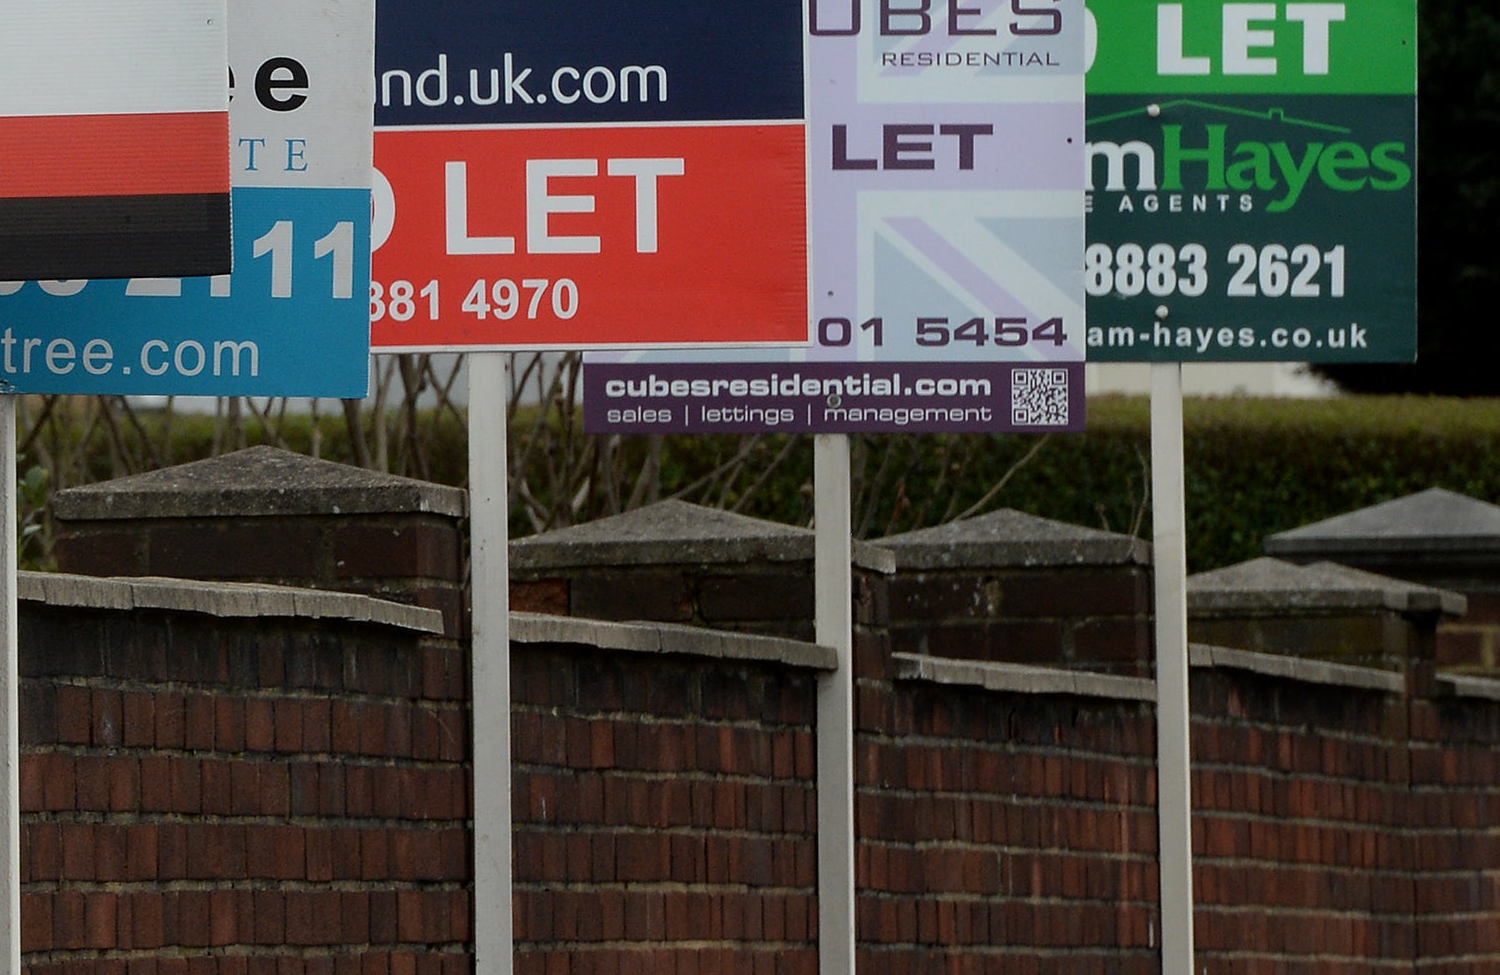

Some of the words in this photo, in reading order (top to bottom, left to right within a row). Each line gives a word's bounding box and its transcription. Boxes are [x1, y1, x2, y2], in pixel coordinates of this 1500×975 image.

[1156, 2, 1346, 76] LET
[881, 52, 1060, 67] RESIDENTIAL
[373, 52, 669, 107] nd.uk.com
[831, 123, 994, 171] LET
[444, 157, 686, 256] LET
[1118, 194, 1253, 213] AGENTS
[1085, 242, 1209, 298] 8883
[1226, 243, 1346, 298] 2621
[460, 277, 580, 321] 4970
[816, 316, 884, 348] 01
[915, 316, 1069, 348] 5454
[1086, 321, 1369, 354] am-hayes.co.uk
[605, 373, 993, 398] cubesresidential.com
[606, 405, 673, 424] sales
[700, 404, 795, 426] lettings
[823, 404, 993, 425] management
